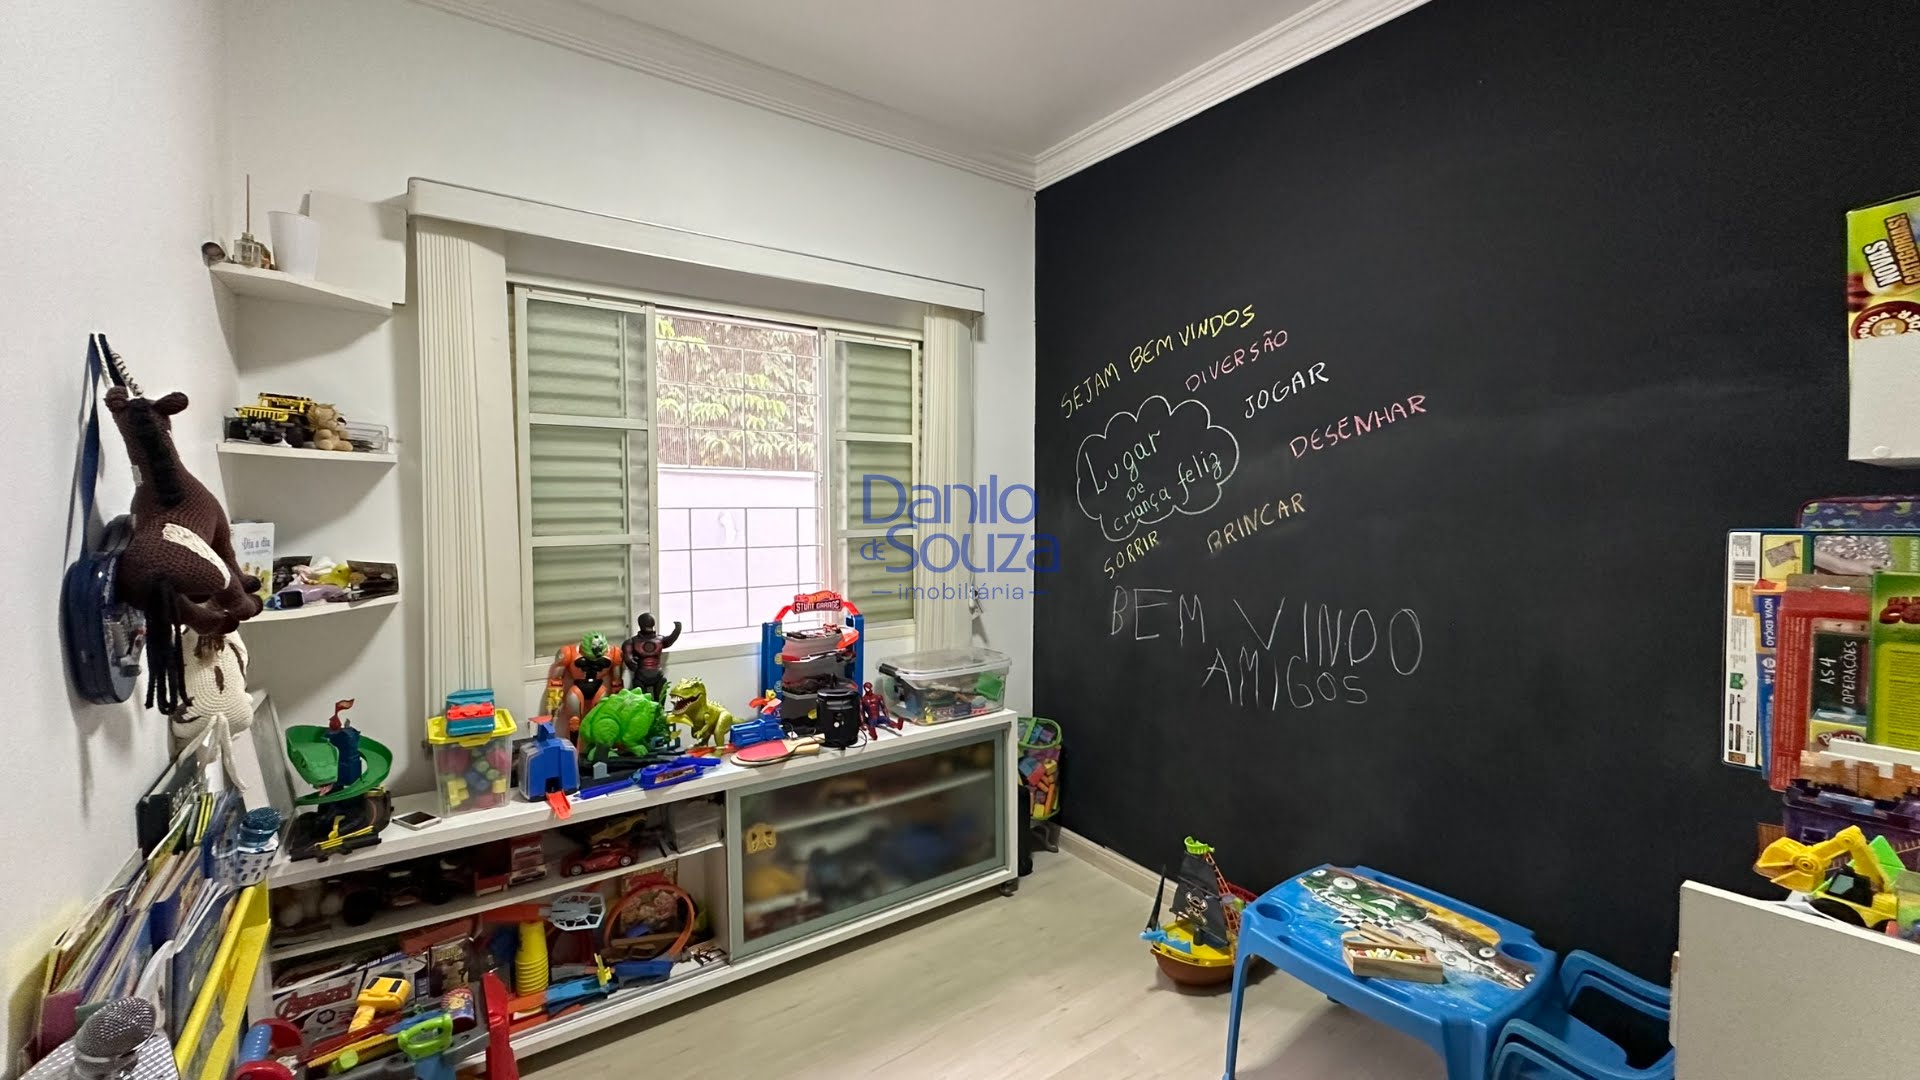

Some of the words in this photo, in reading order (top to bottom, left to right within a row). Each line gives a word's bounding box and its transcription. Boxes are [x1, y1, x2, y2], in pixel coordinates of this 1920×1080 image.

[1864, 241, 1902, 286] NOVAS
[1060, 362, 1120, 419] SEJAM
[1129, 335, 1174, 373] BEM
[1178, 304, 1256, 346] VINDOS
[1184, 329, 1288, 391] DIVERSÃO
[1244, 361, 1329, 419] JOGAR
[1289, 394, 1427, 458] DESENHAR
[1084, 429, 1161, 495] Lugar
[1177, 450, 1222, 506] feliz
[1206, 492, 1306, 554] BRINCAR
[1103, 530, 1161, 580] SORRIR
[1110, 585, 1206, 648] BEM
[1763, 598, 1773, 619] NOVA
[1763, 619, 1775, 646] EDIÇÃO
[1201, 645, 1369, 712] AMIGOS
[1819, 668, 1835, 685] AS
[1841, 640, 1857, 705] OPERAÇÕES
